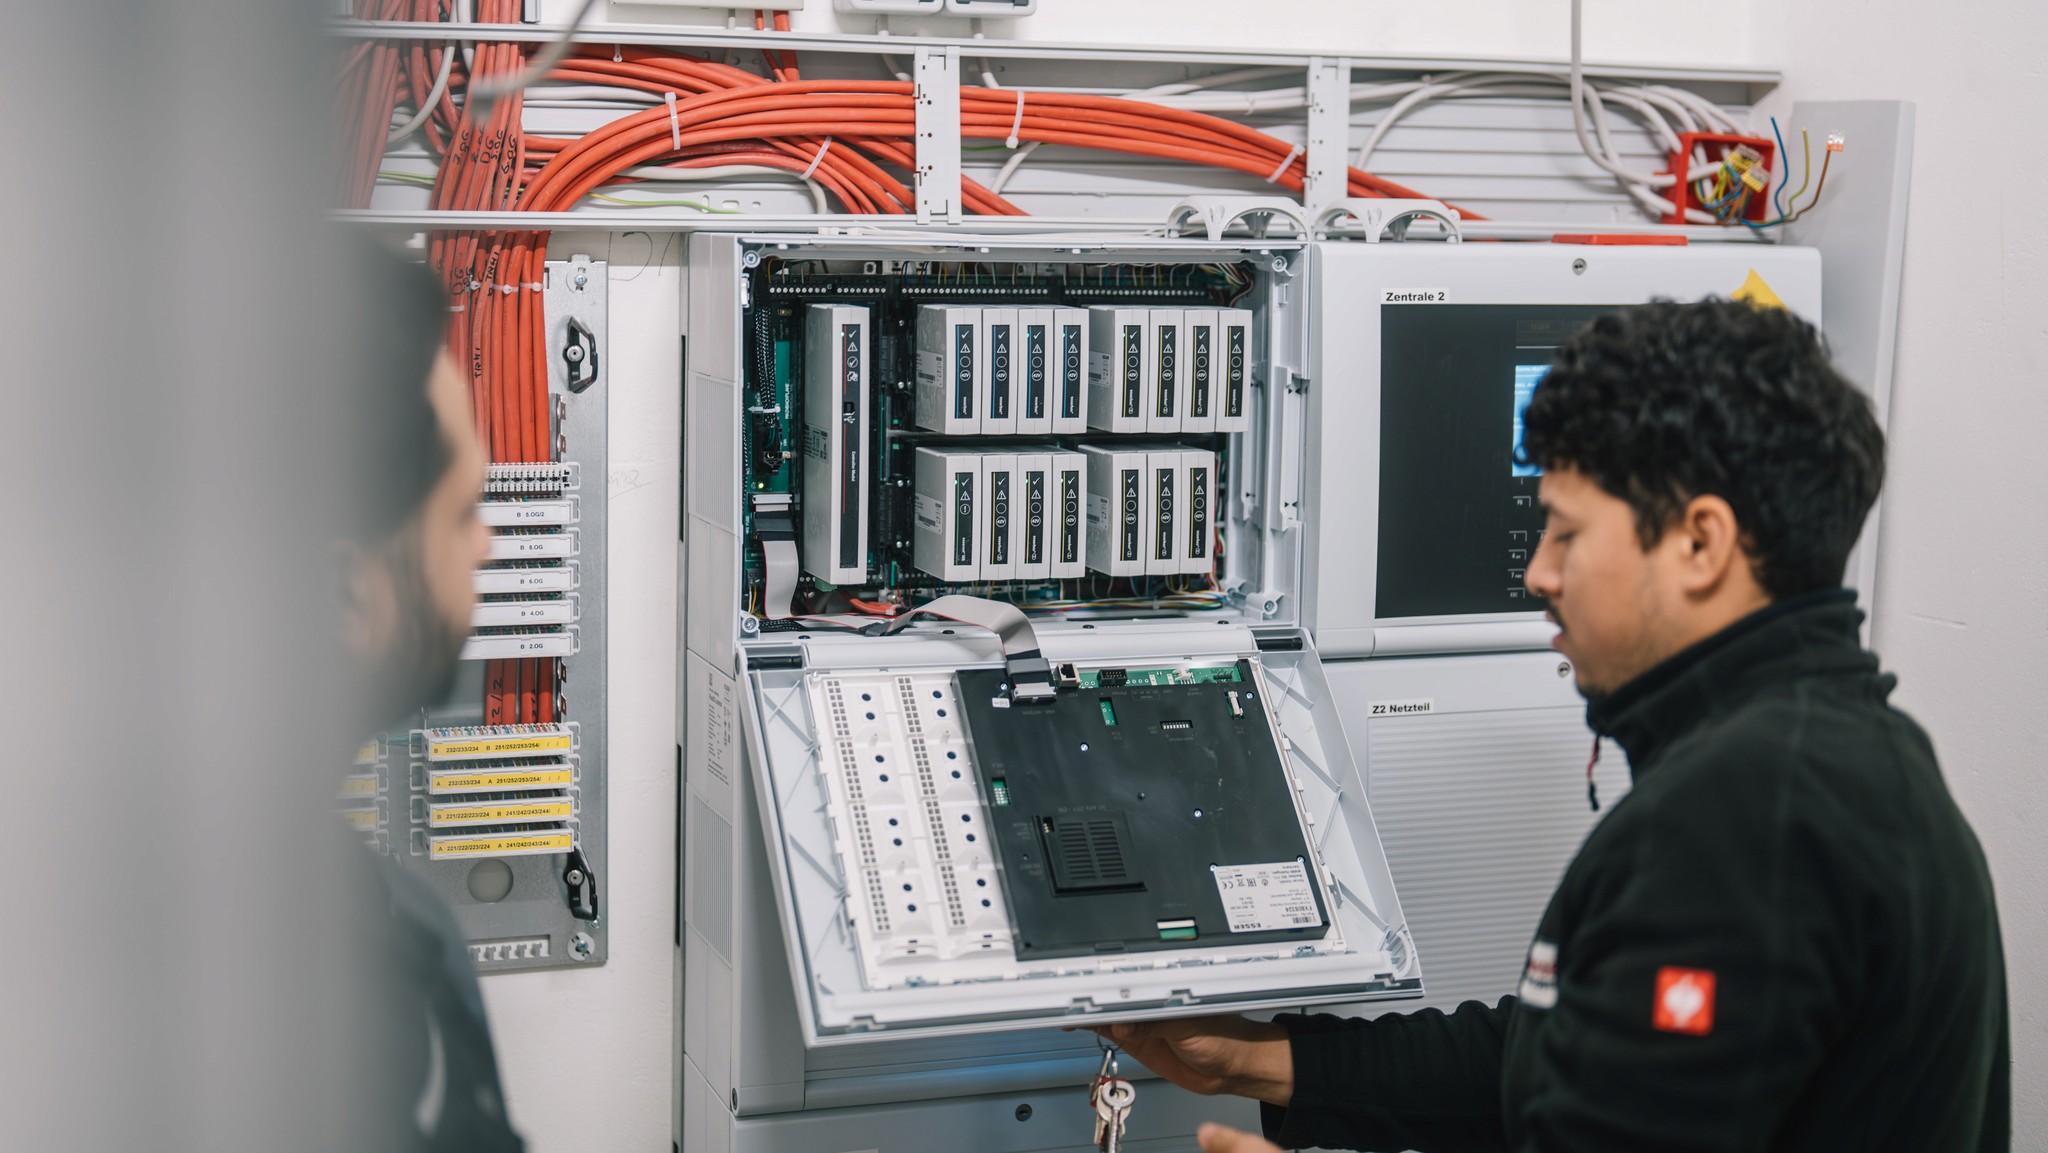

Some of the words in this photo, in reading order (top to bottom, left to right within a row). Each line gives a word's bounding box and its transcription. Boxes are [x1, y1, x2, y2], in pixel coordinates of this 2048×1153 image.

[480, 136, 494, 164] DG
[1386, 292, 1434, 302] Zentrale
[1438, 291, 1445, 301] 2
[1372, 705, 1386, 714] Z2
[1389, 702, 1430, 713] Netzteil
[448, 779, 481, 787] 232/233/234
[1234, 922, 1262, 930] ESSER
